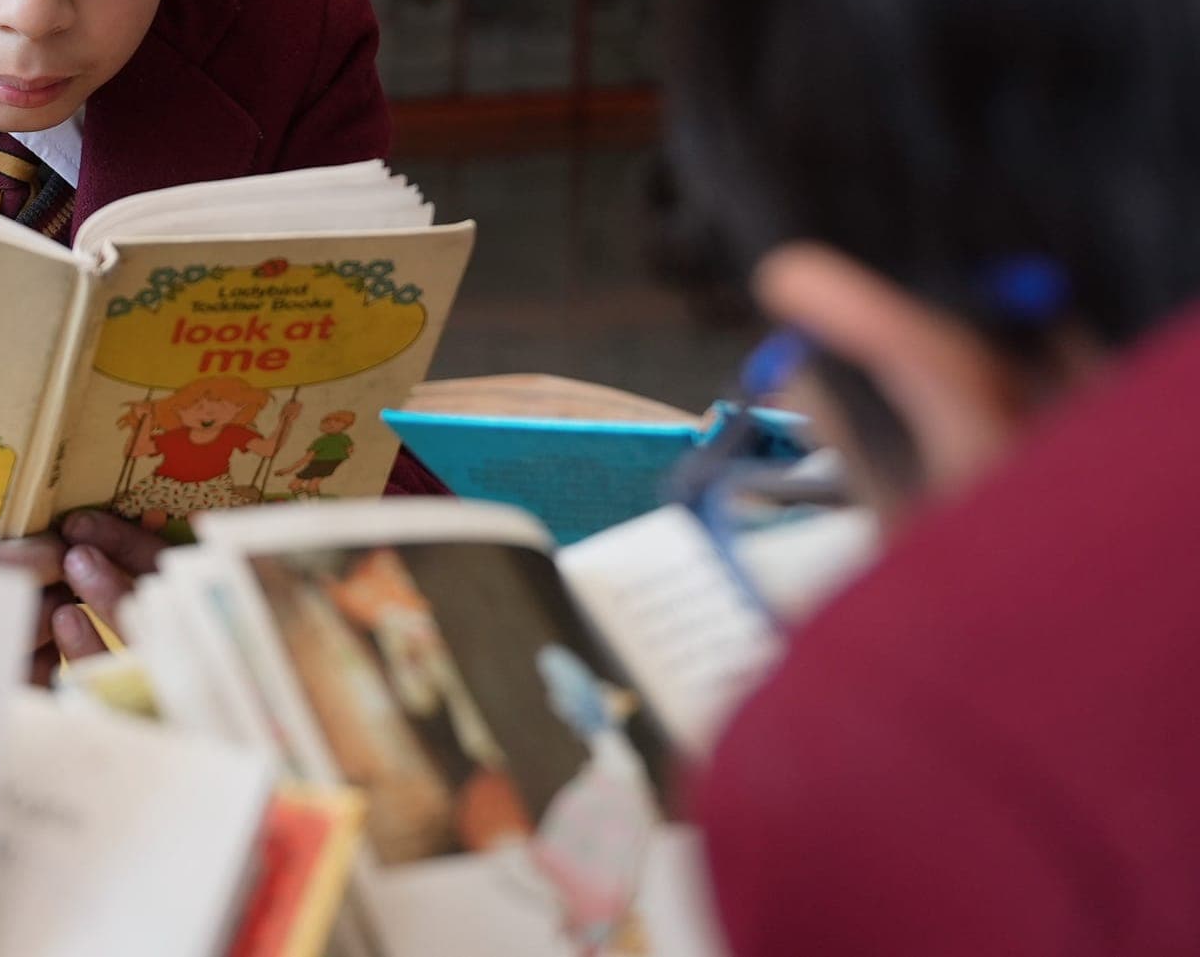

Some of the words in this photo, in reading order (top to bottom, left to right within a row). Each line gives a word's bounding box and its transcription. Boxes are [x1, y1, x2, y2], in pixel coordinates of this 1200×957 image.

[218, 284, 310, 298] Ladybird
[192, 300, 263, 312] Toddler
[271, 297, 335, 312] Books
[171, 315, 272, 346] look
[283, 313, 337, 342] at
[198, 347, 291, 373] me
